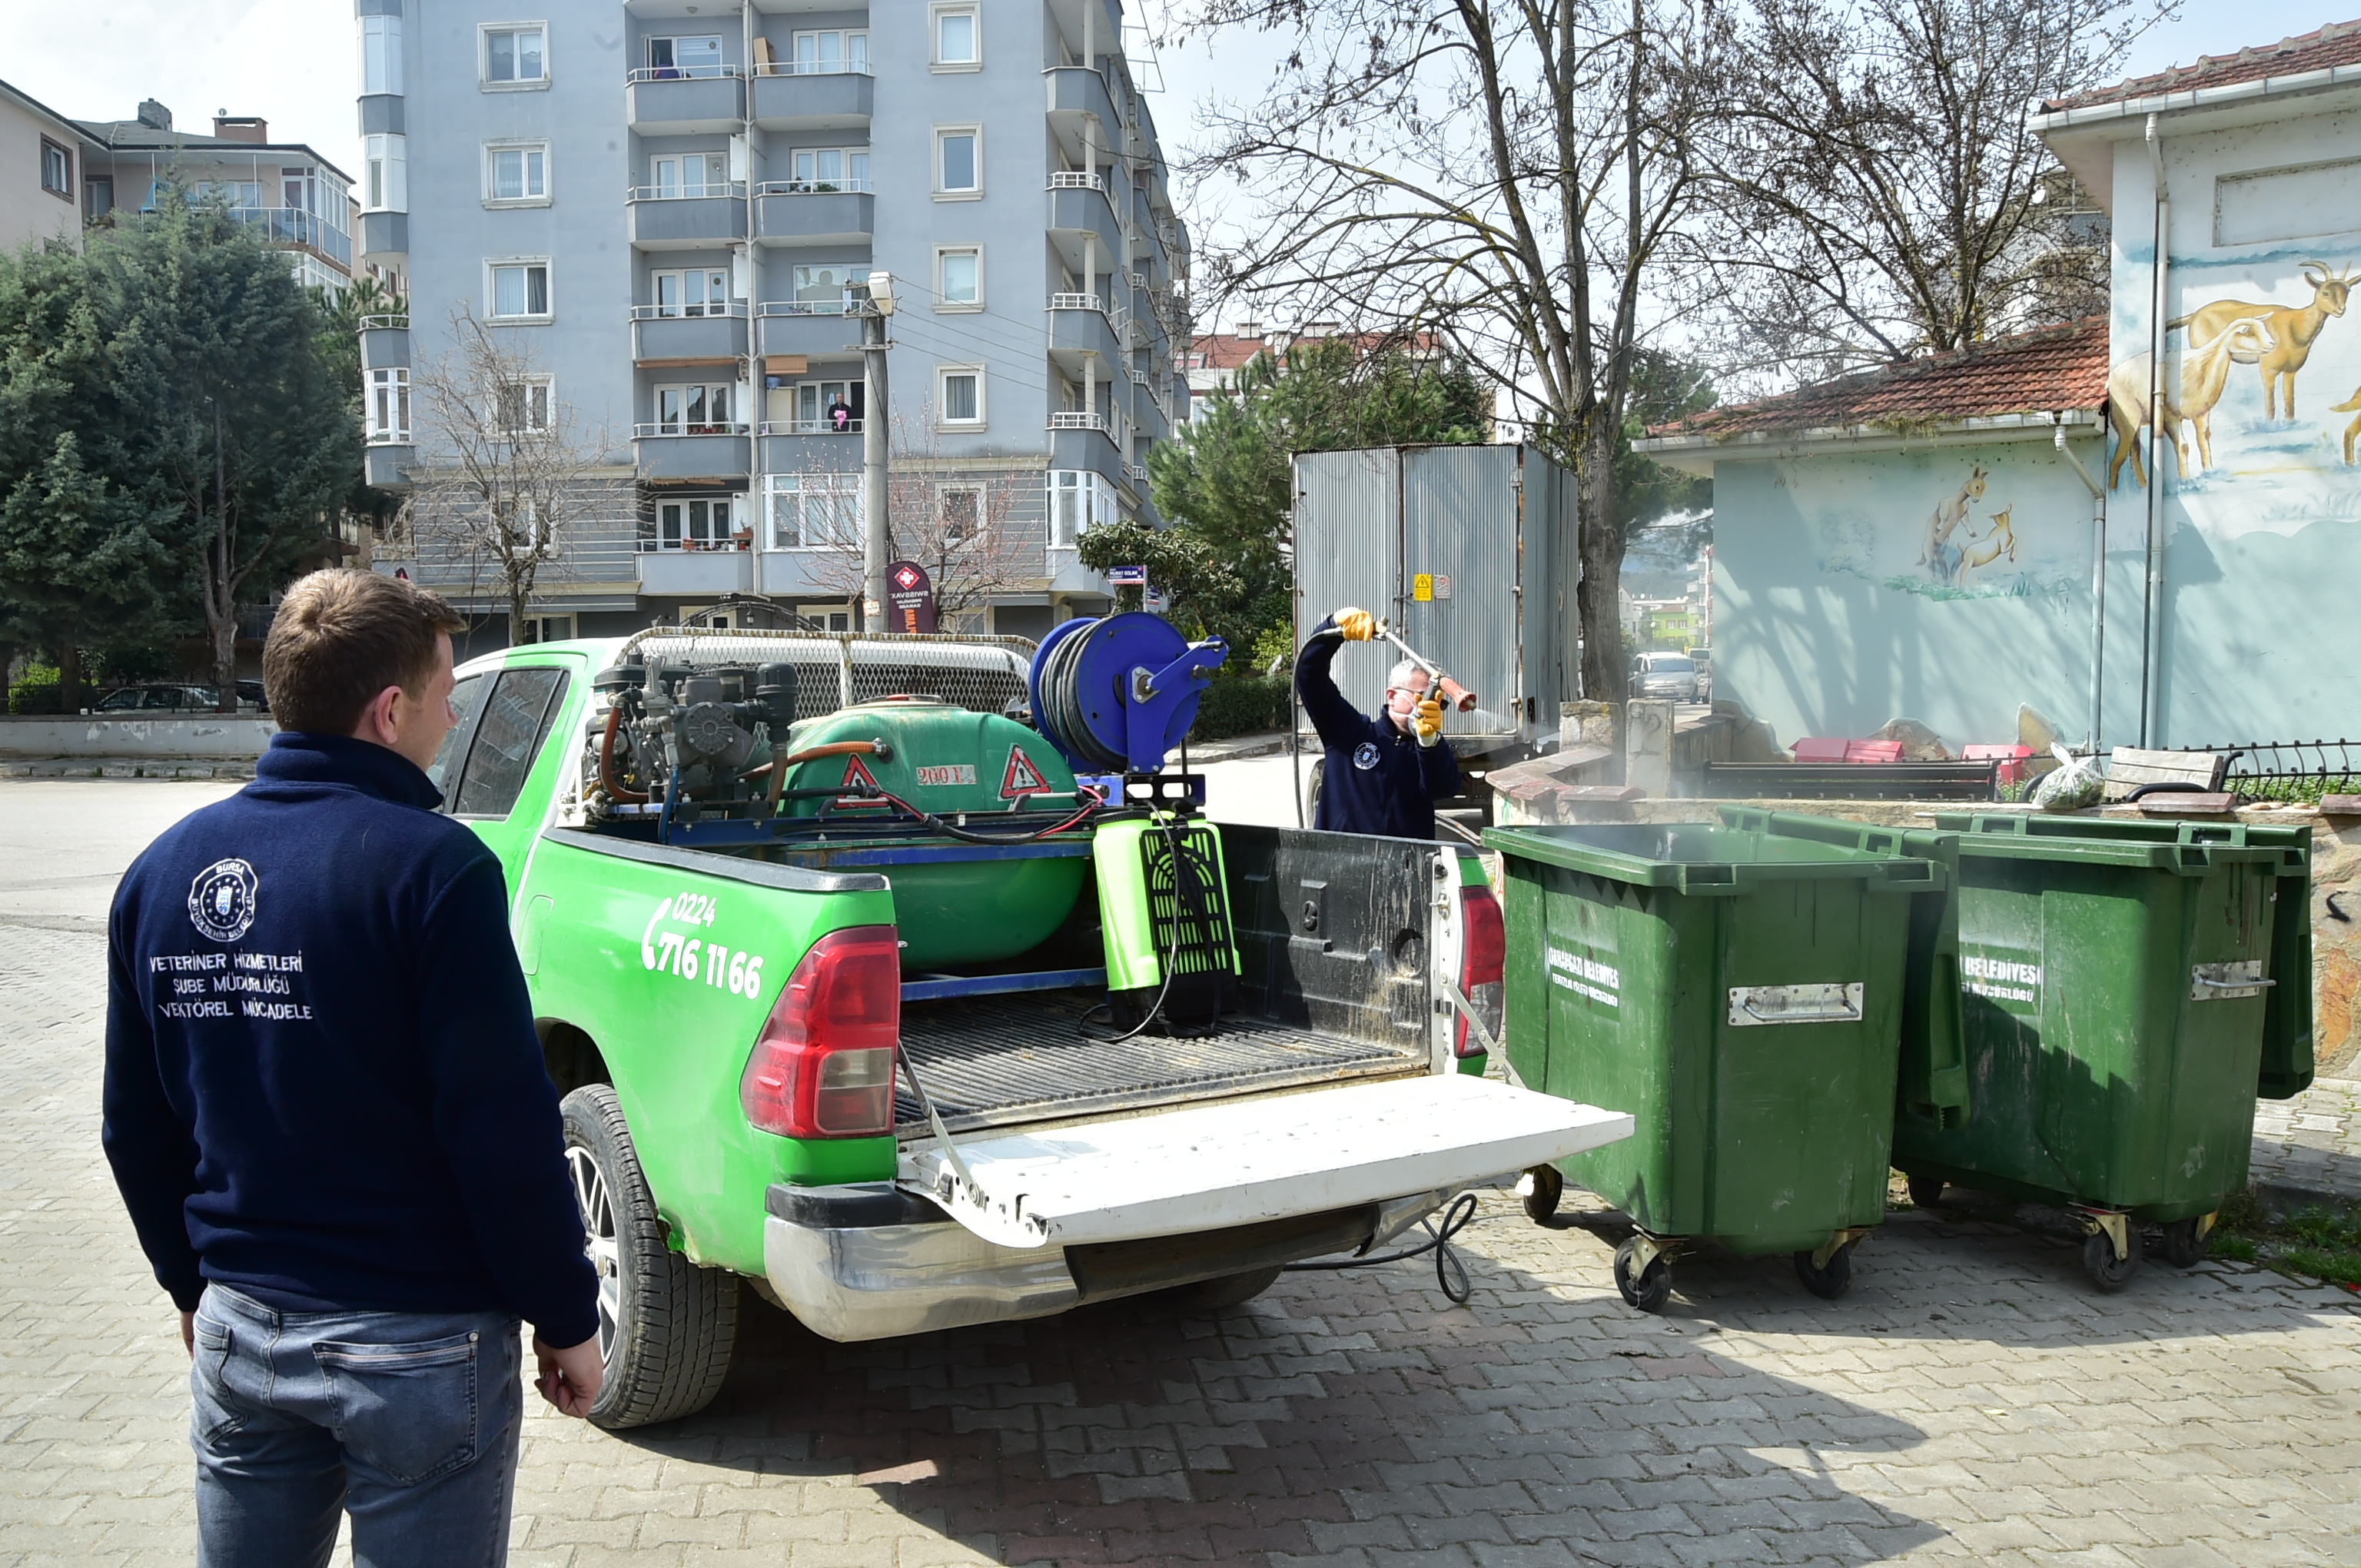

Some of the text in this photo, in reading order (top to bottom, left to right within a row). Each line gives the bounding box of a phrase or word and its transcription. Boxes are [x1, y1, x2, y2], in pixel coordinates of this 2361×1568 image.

[918, 767, 949, 784] 200
[216, 862, 244, 875] BURSA
[671, 892, 717, 928] 0224
[150, 948, 303, 973] VETERİNER HİZMETLERİ
[656, 931, 764, 1000] 716 11 66
[173, 972, 291, 996] ŞUBE MÜDÜRLÜĞÜ
[158, 997, 313, 1020] VEKTÖREL MÜCADELE
